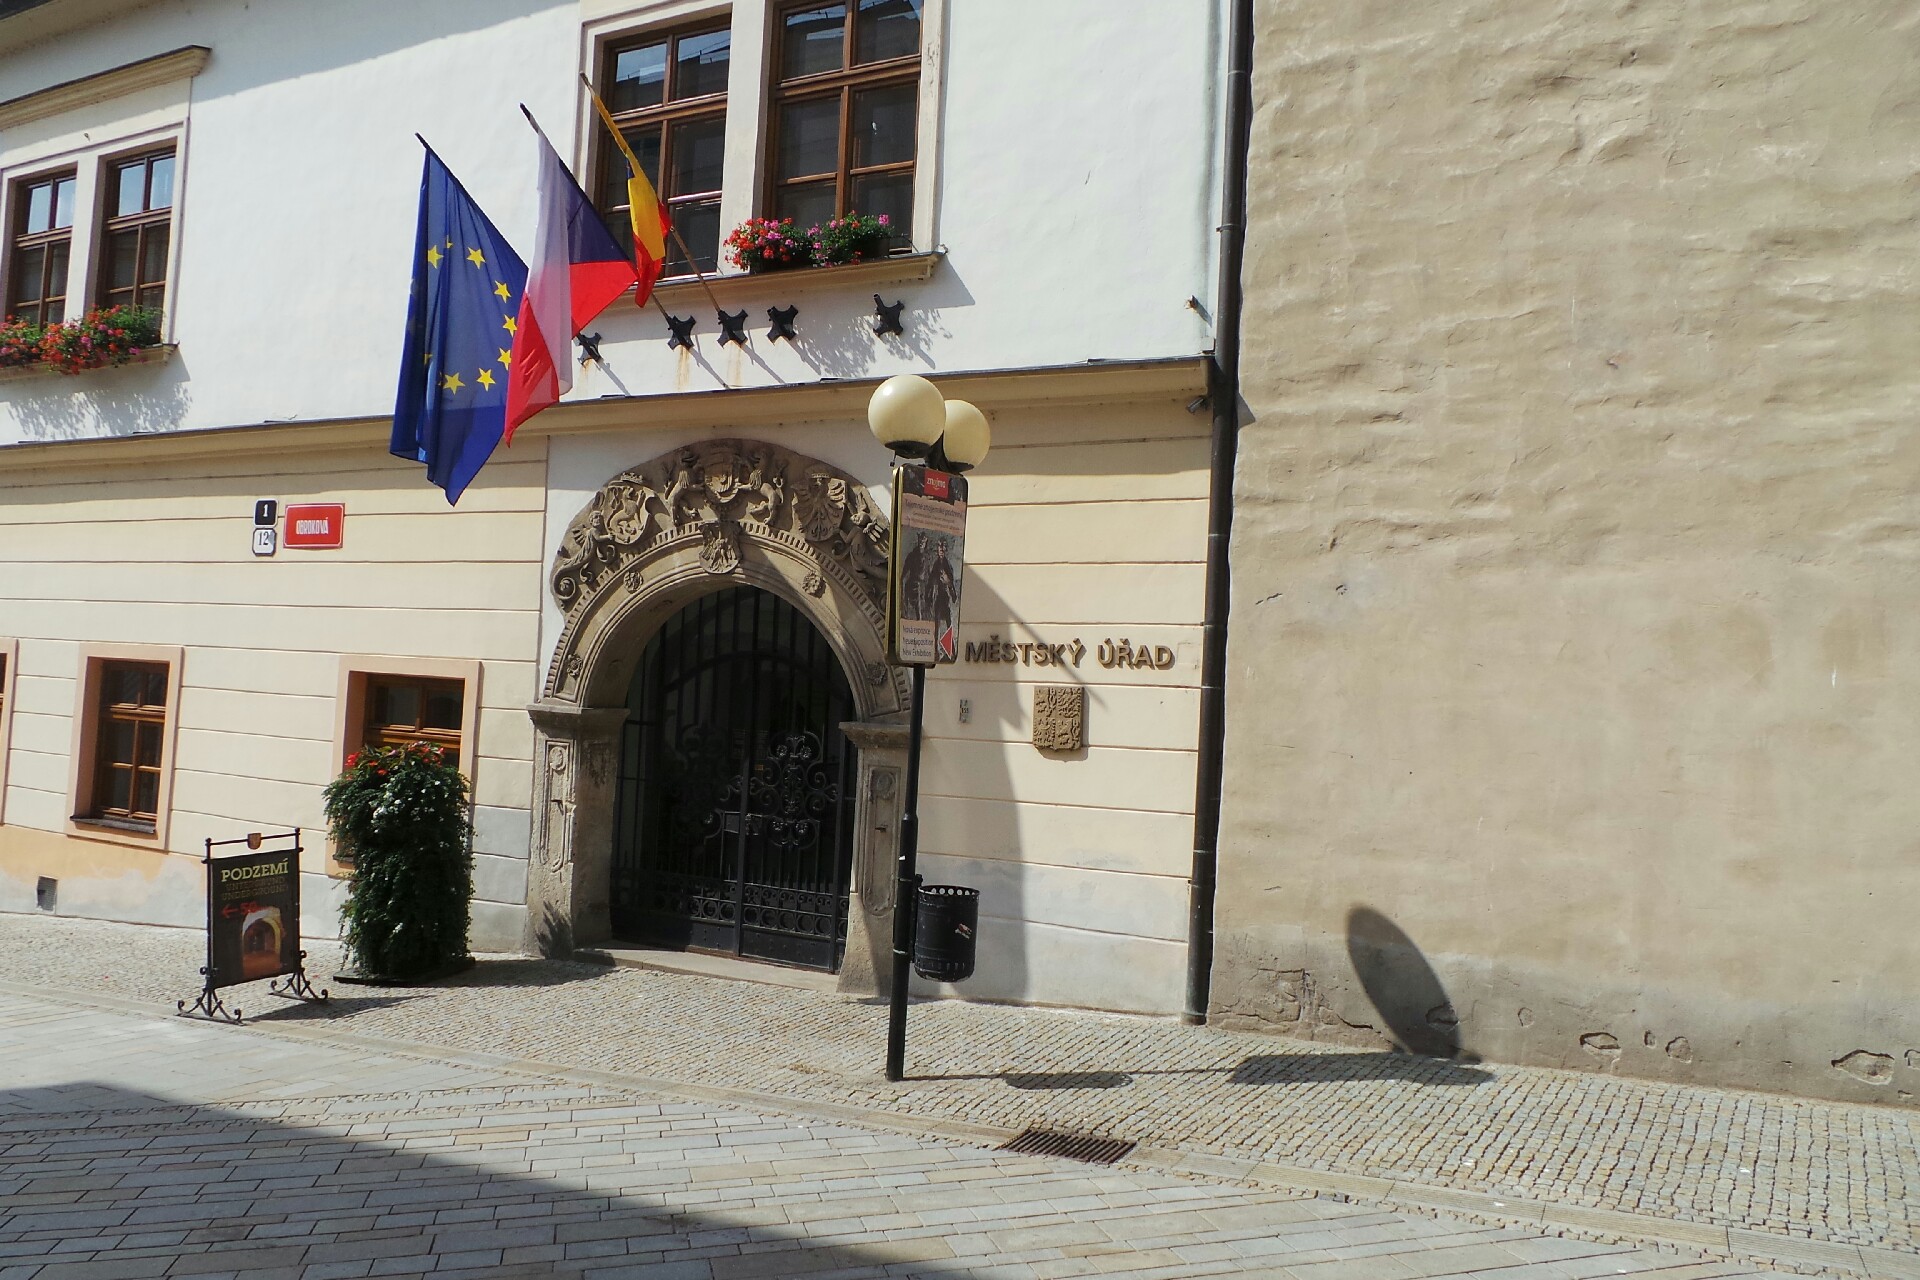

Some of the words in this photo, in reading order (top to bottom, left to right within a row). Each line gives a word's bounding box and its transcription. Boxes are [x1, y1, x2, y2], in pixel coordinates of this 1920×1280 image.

[263, 504, 269, 517] 1
[296, 517, 328, 535] OBROKOVÁ
[258, 531, 269, 546] 12
[964, 634, 1083, 668] MĚSTSKÝ
[1097, 637, 1174, 669] ÚŘAD
[221, 858, 288, 882] PODZEMÍ
